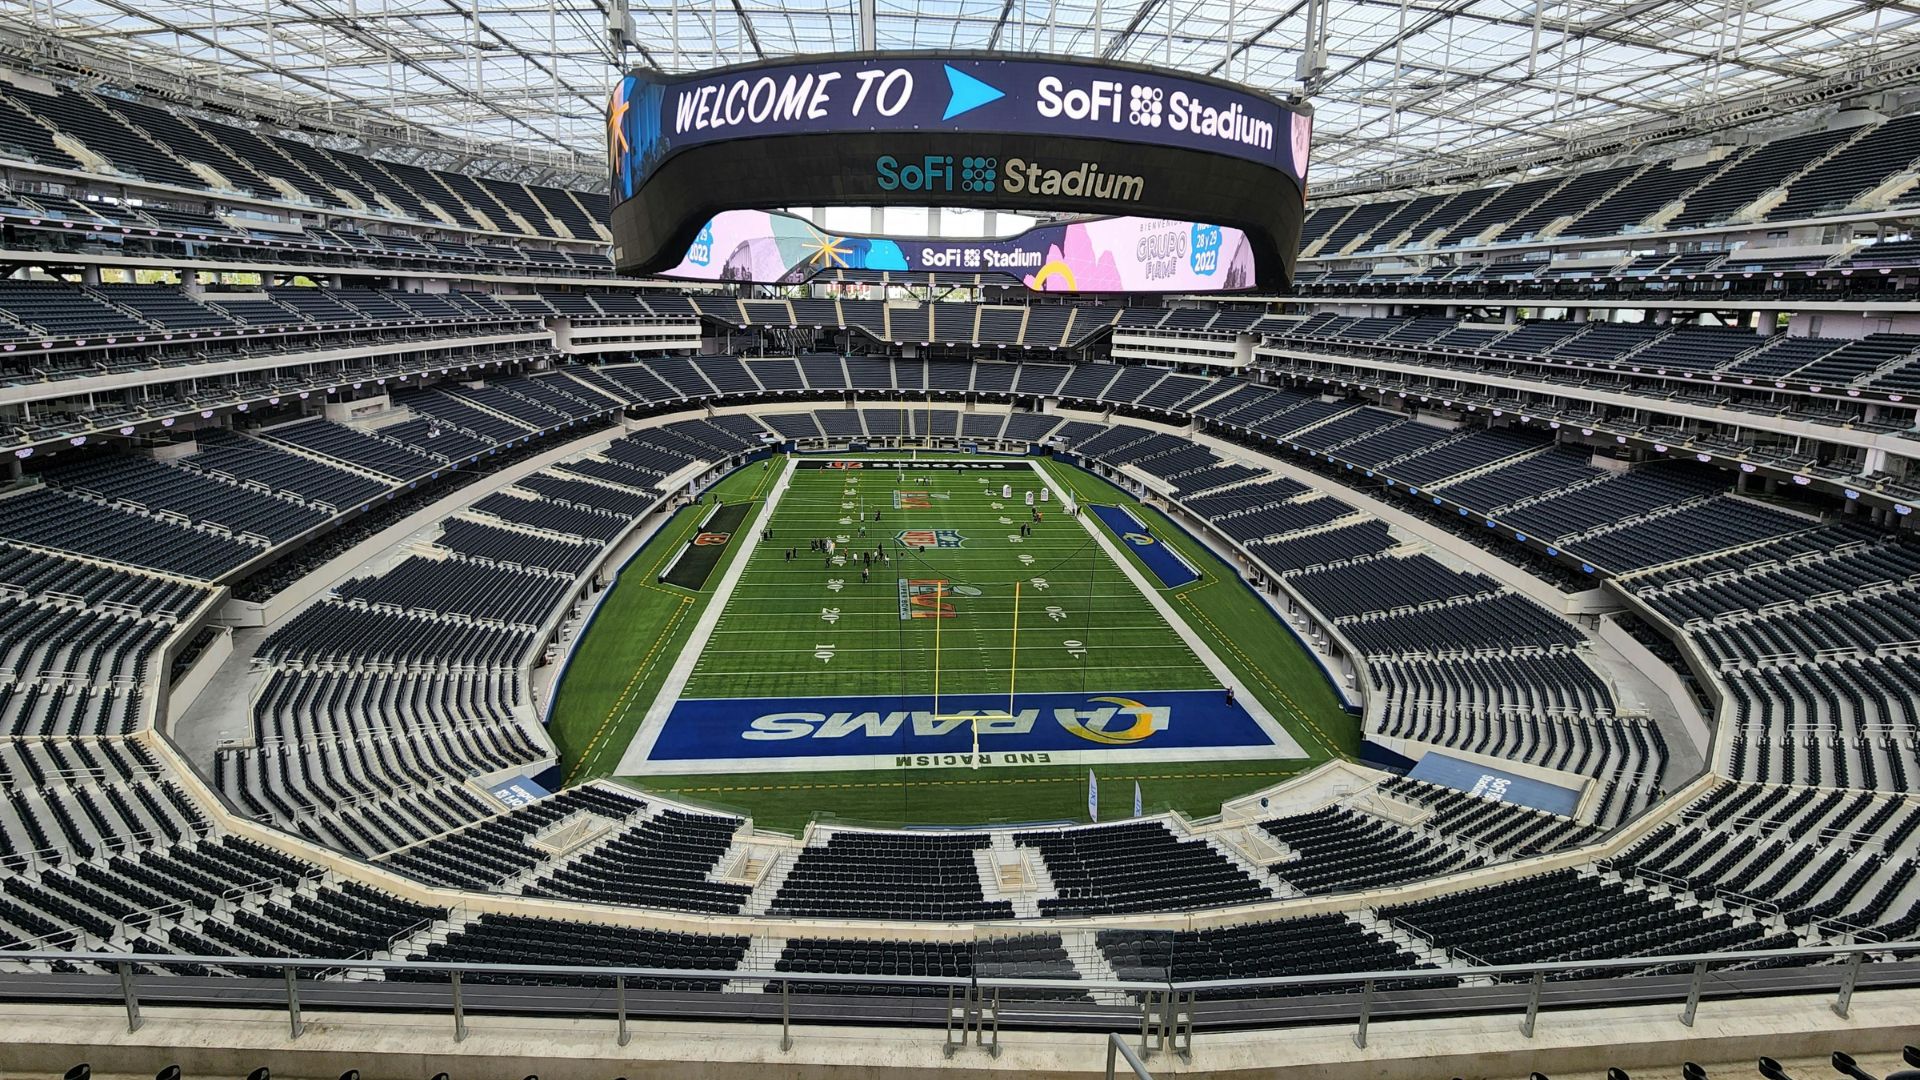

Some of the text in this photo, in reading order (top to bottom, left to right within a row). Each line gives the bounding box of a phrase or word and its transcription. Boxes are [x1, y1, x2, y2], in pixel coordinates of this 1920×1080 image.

[675, 68, 914, 134] WELCOME TO
[1036, 76, 1274, 150] SoFi Stadium
[876, 155, 1145, 201] SoFi Stadium
[1137, 231, 1187, 262] GRUPO
[1196, 234, 1205, 248] 28
[1210, 230, 1218, 246] 29
[921, 248, 1042, 267] SoFi Stadium
[1194, 250, 1216, 272] 2022
[814, 643, 836, 659] 10
[1063, 640, 1088, 655] 10
[741, 708, 1041, 741] RAMS
[895, 752, 1051, 767] END RACISM
